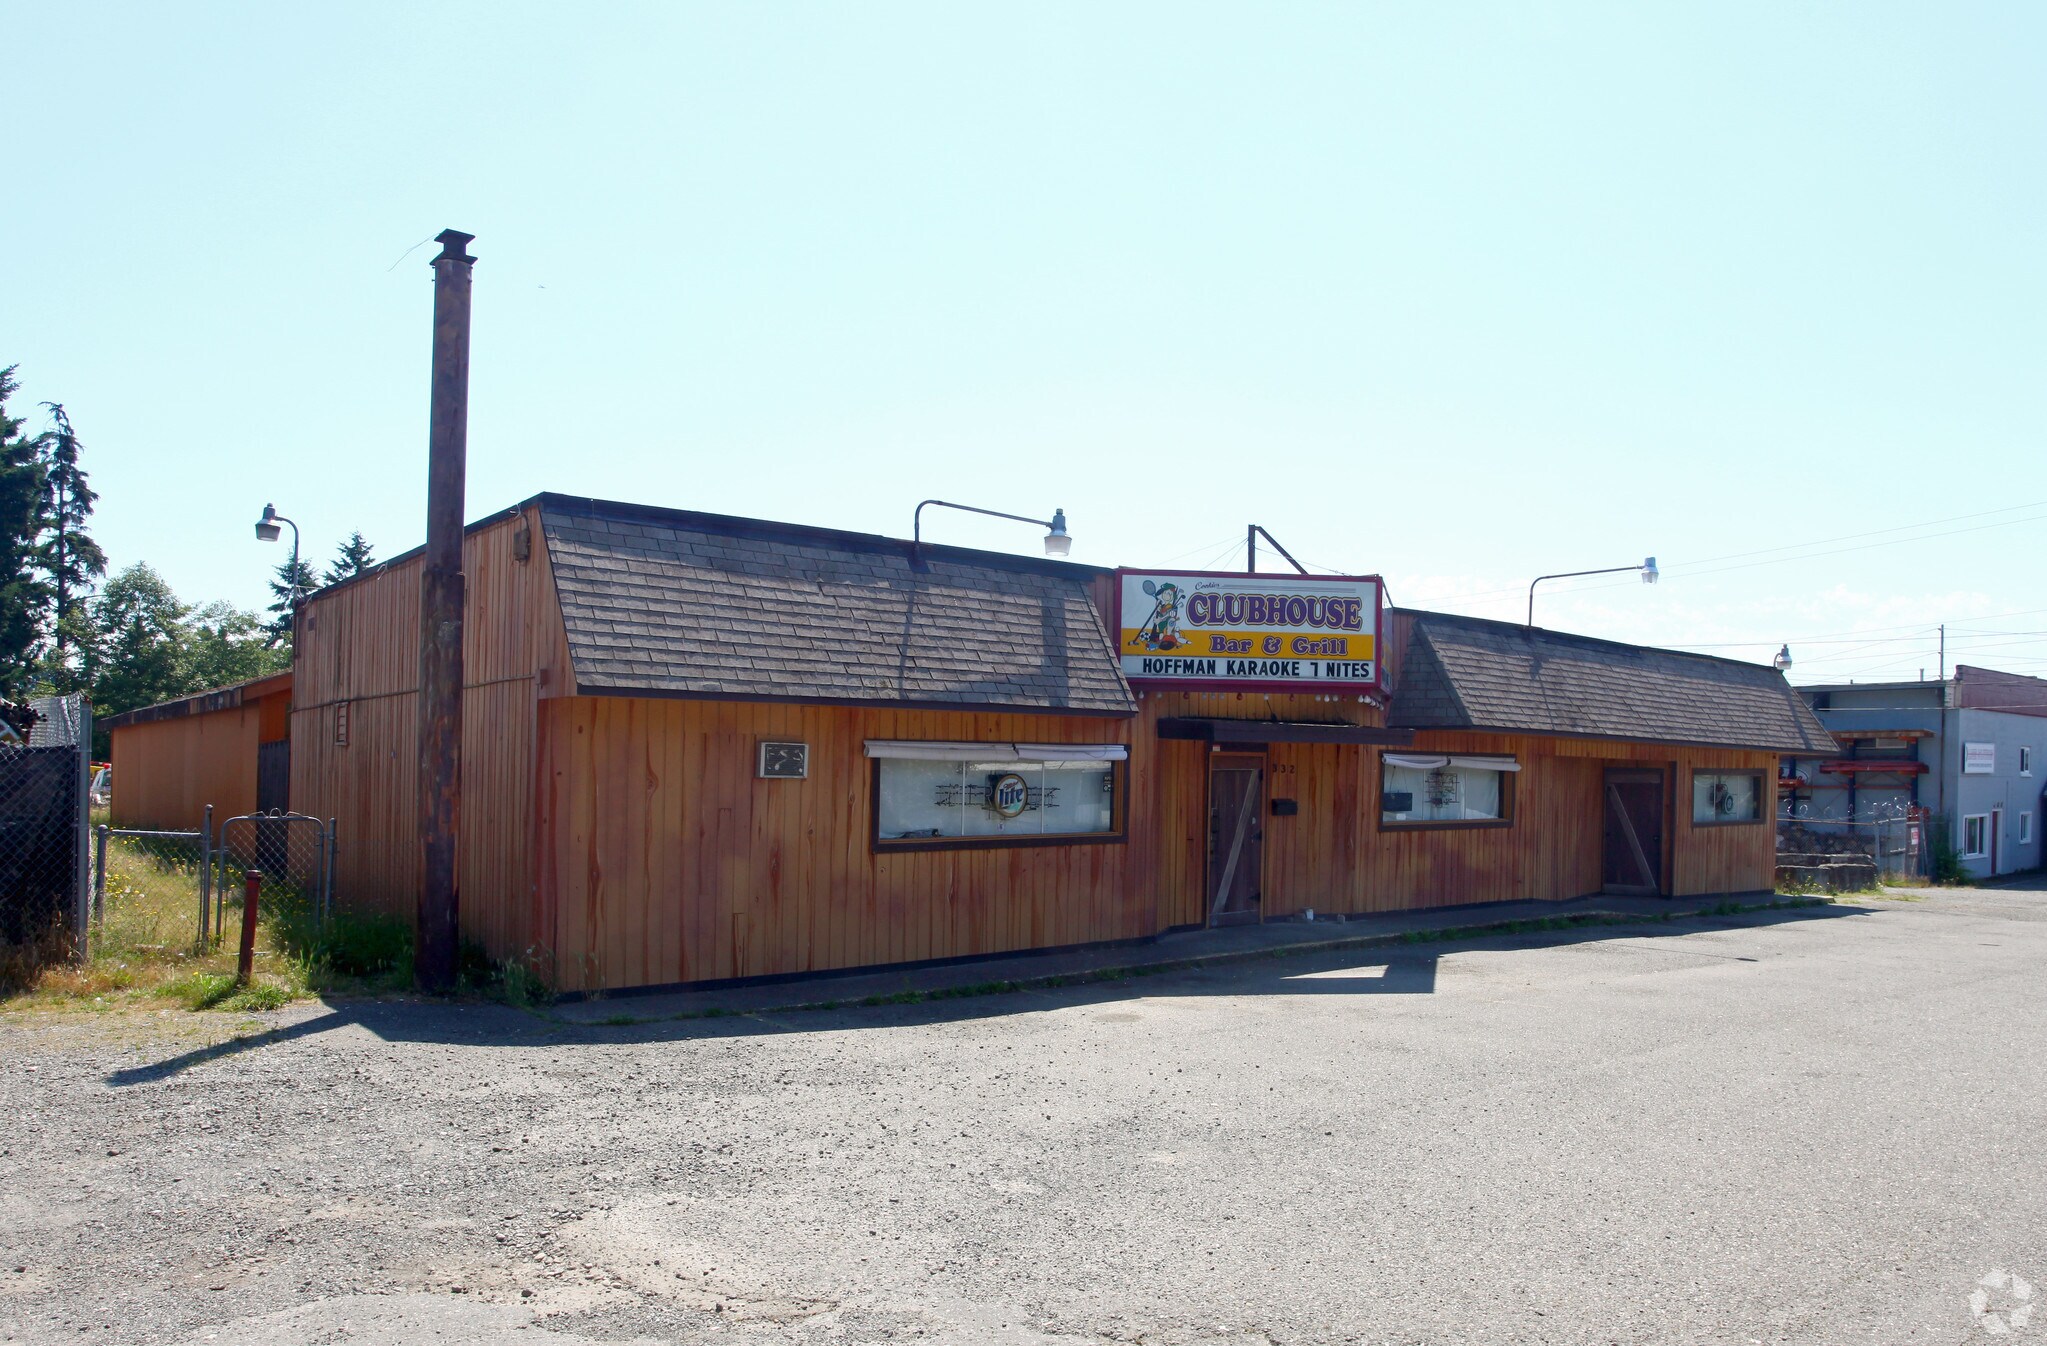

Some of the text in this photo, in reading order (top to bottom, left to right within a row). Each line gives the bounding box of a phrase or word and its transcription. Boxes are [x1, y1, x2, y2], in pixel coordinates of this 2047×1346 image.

[1186, 592, 1362, 631] CLUBHOUSE
[1209, 634, 1348, 656] Bar & Grill
[1143, 658, 1216, 676] HOFFMAN
[1227, 660, 1300, 677] KARAOKE
[1326, 662, 1370, 678] NITES
